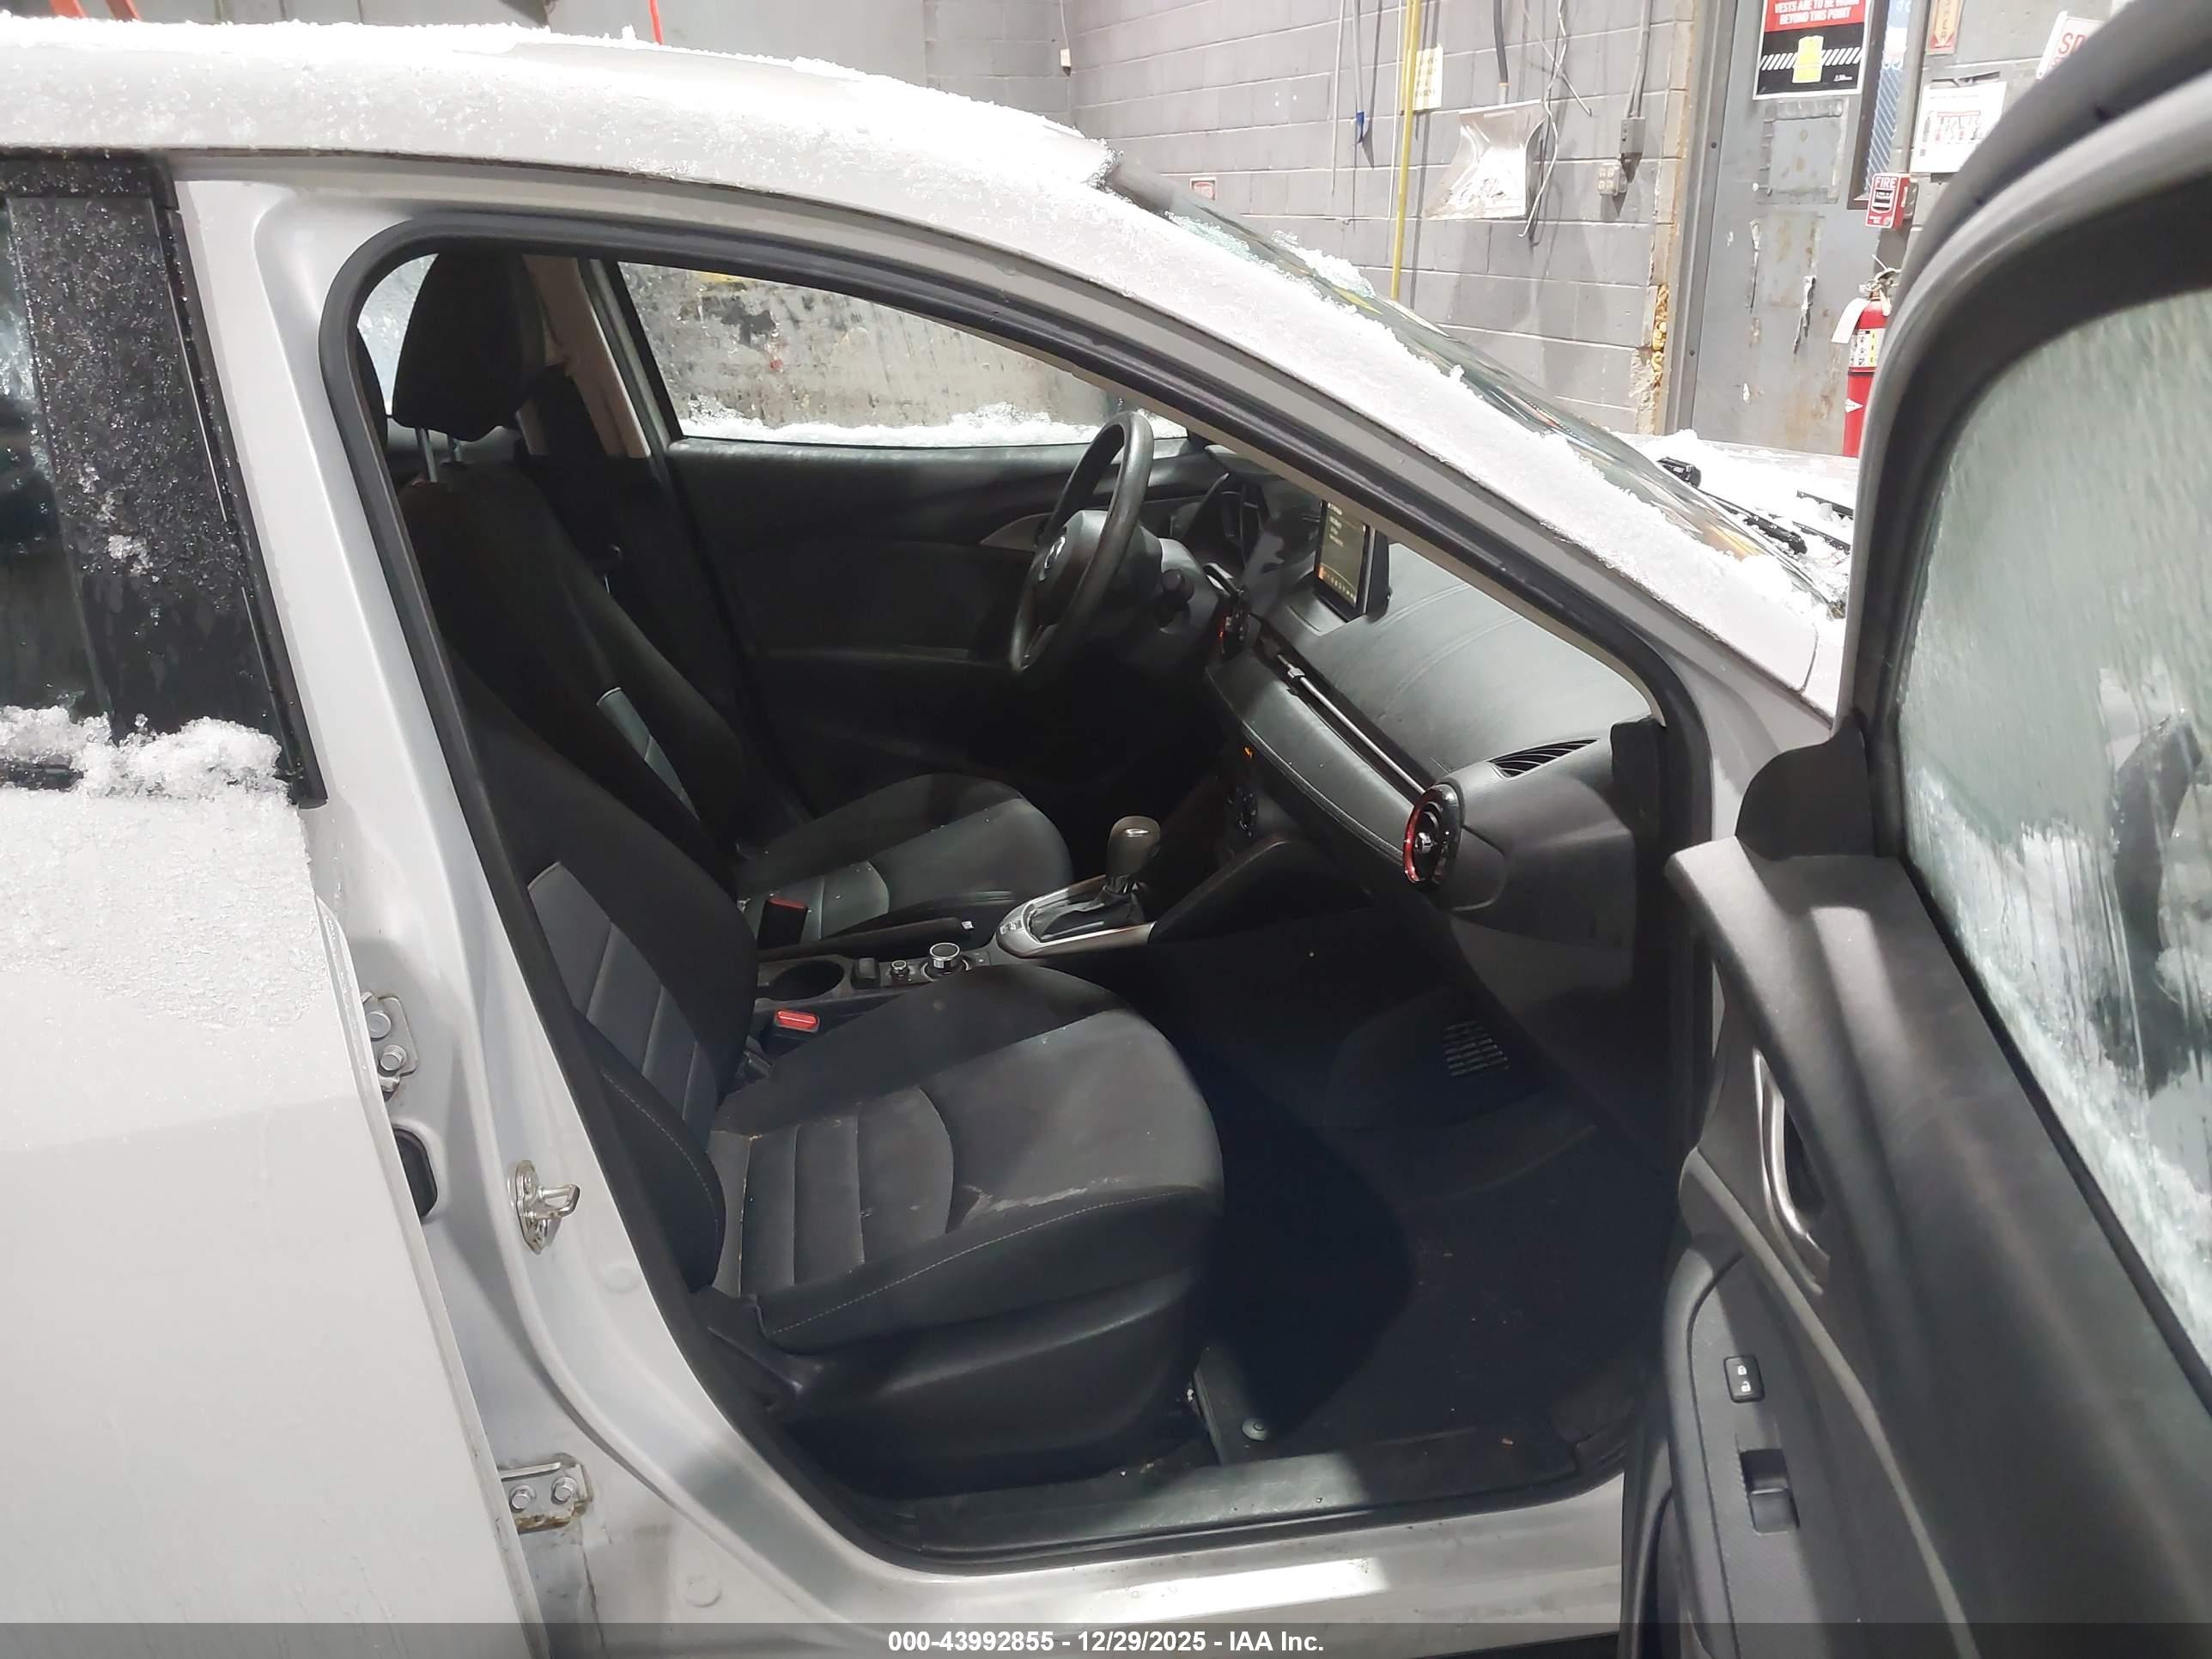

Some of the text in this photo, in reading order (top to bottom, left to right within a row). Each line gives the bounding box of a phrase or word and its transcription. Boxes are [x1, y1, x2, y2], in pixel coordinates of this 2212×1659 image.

[1778, 6, 1852, 25] BEYOND THIS POINT
[1874, 176, 1898, 189] FIRE
